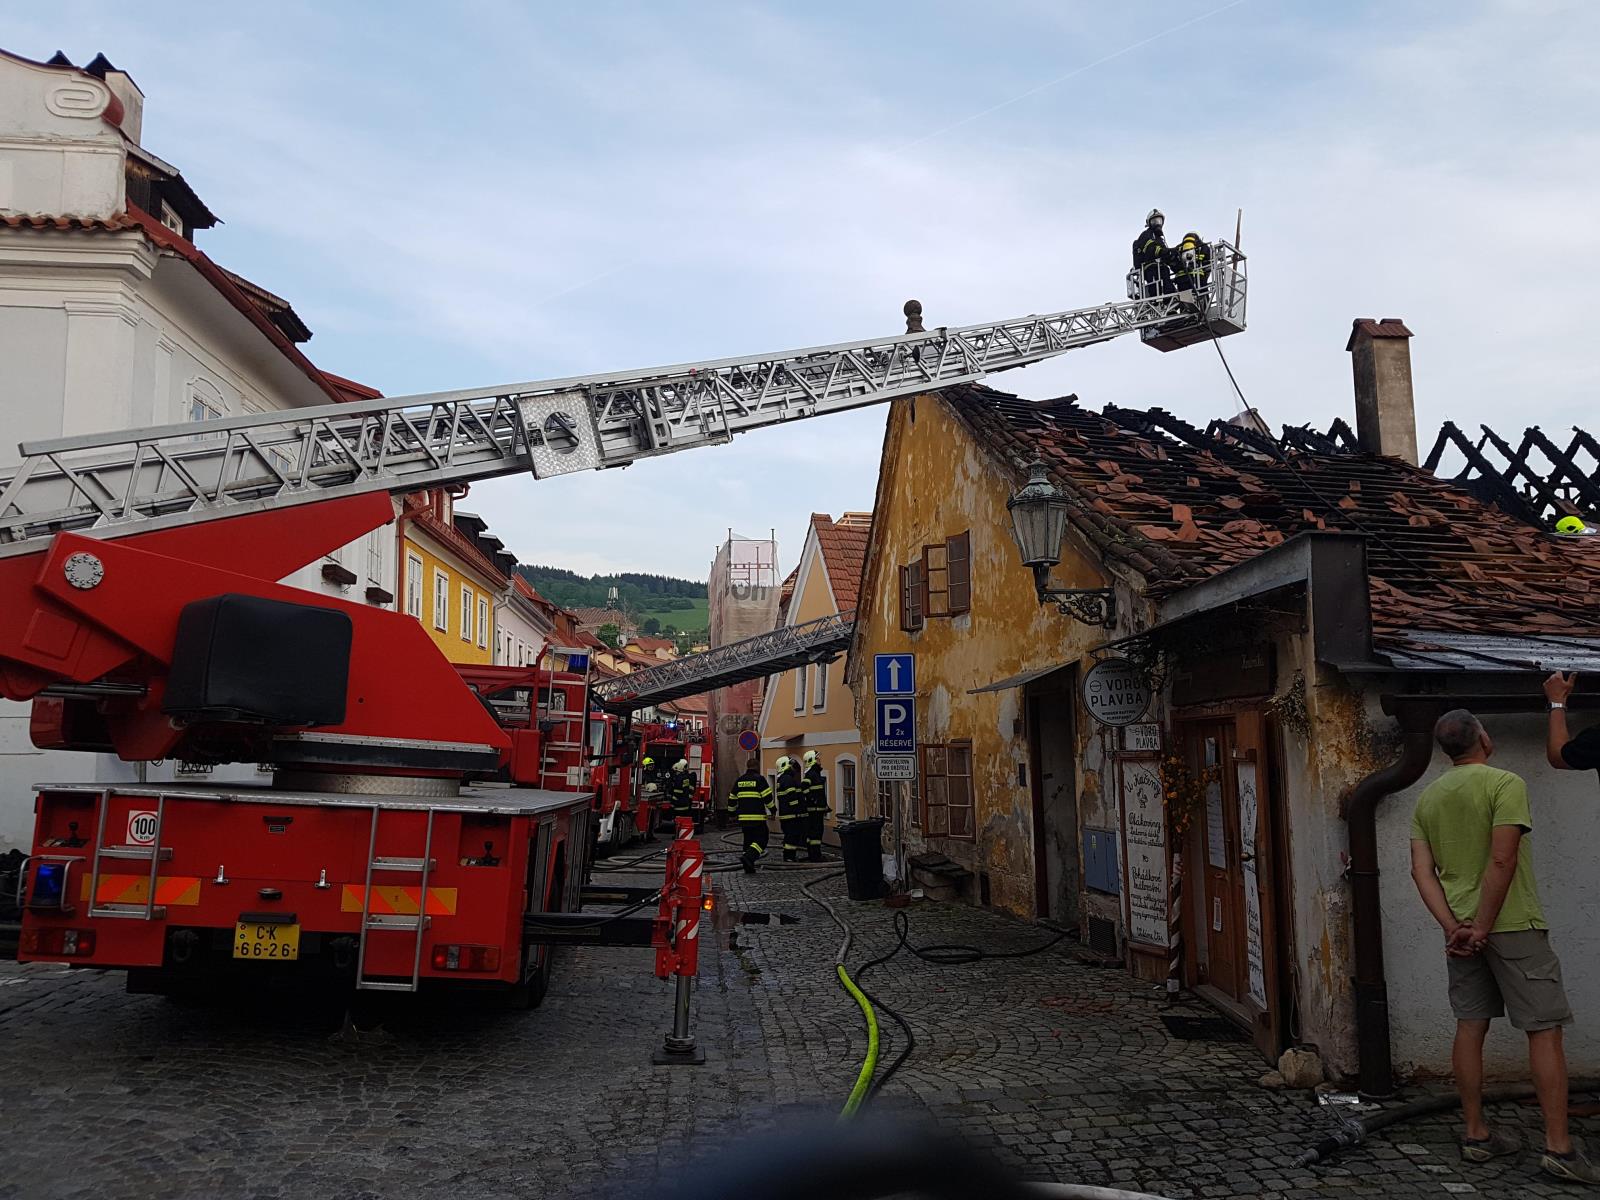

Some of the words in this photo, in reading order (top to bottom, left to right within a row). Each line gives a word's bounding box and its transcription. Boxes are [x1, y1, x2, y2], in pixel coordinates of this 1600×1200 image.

[1091, 692, 1143, 707] PLAVBA
[884, 704, 907, 736] P
[895, 728, 905, 736] 2x
[879, 737, 913, 747] RÉSERVÉ
[1135, 737, 1158, 750] PLAVBA
[134, 817, 156, 836] 100
[241, 942, 290, 957] 66-26
